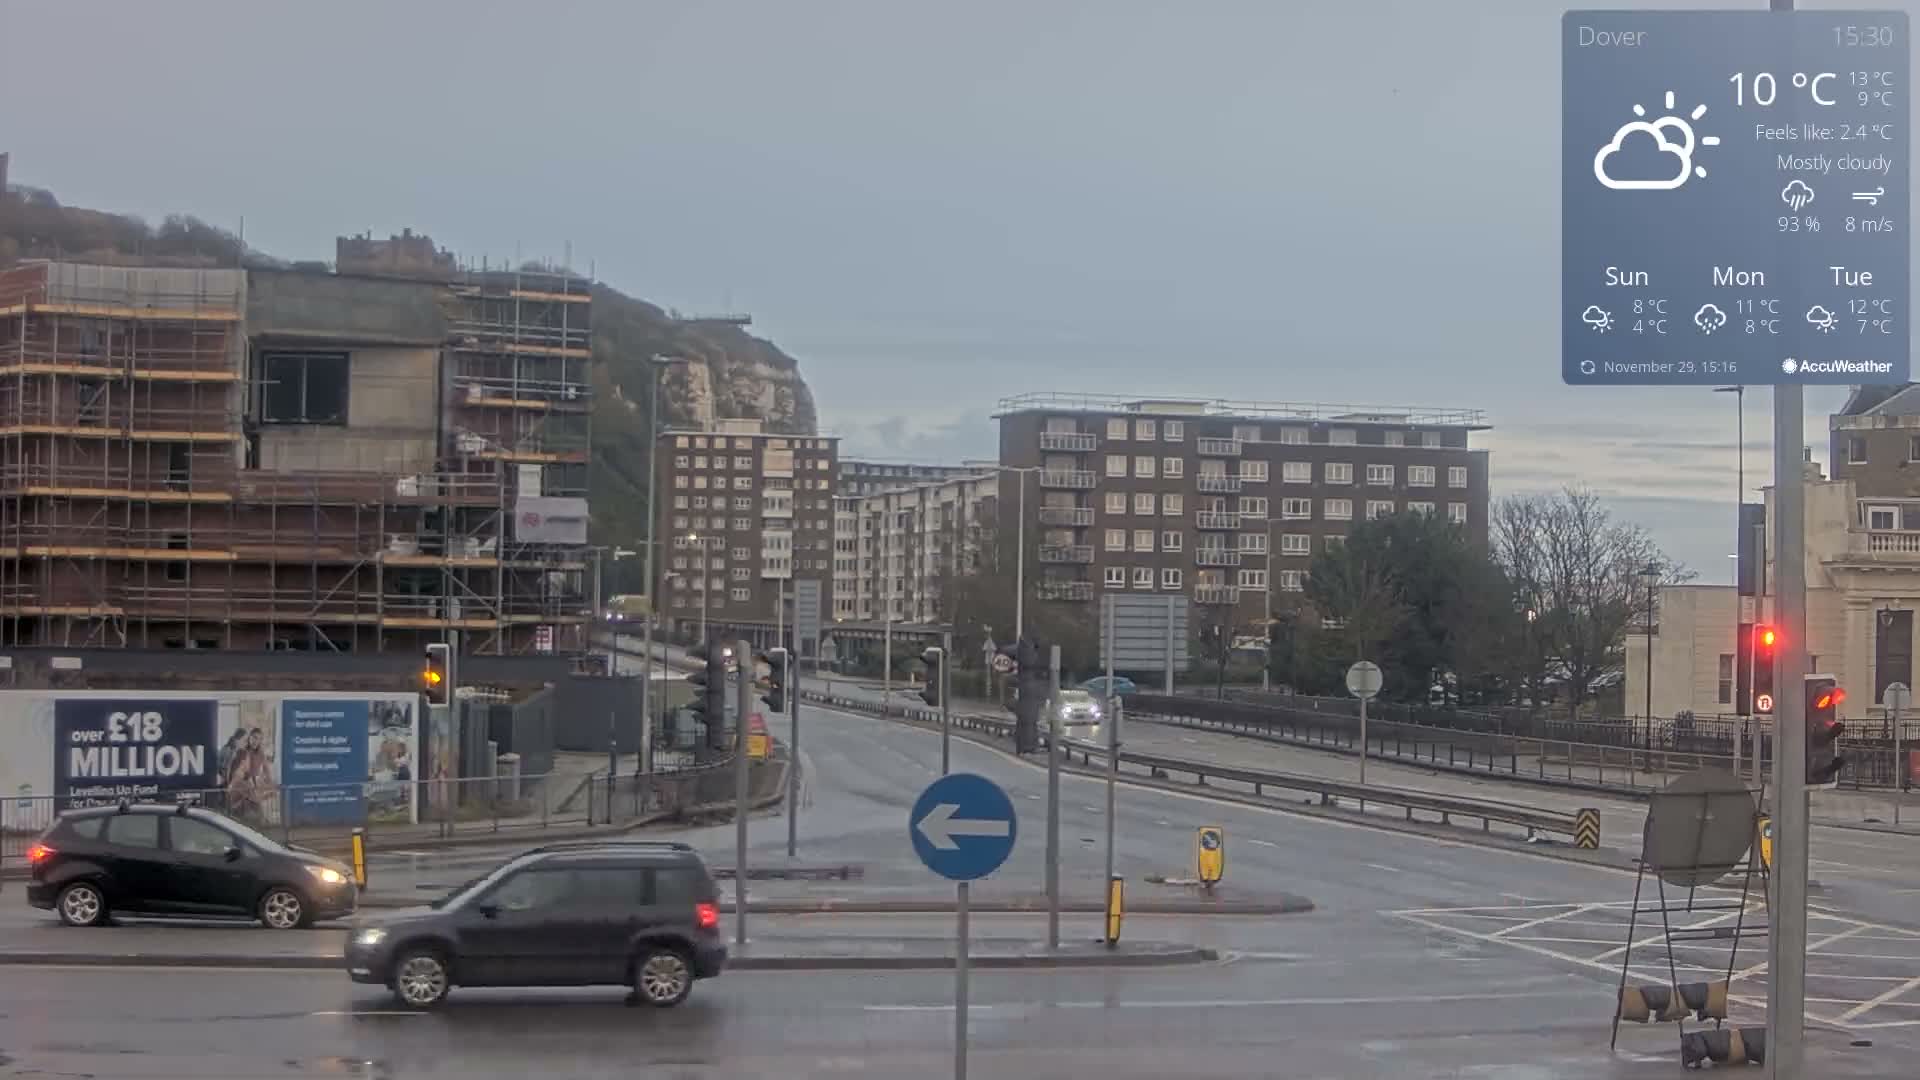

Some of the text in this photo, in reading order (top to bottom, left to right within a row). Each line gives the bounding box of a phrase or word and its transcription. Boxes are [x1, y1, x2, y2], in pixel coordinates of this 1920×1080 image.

[71, 711, 163, 742] over £18
[71, 745, 205, 777] MILLION
[70, 784, 158, 797] Levelling Up Fund
